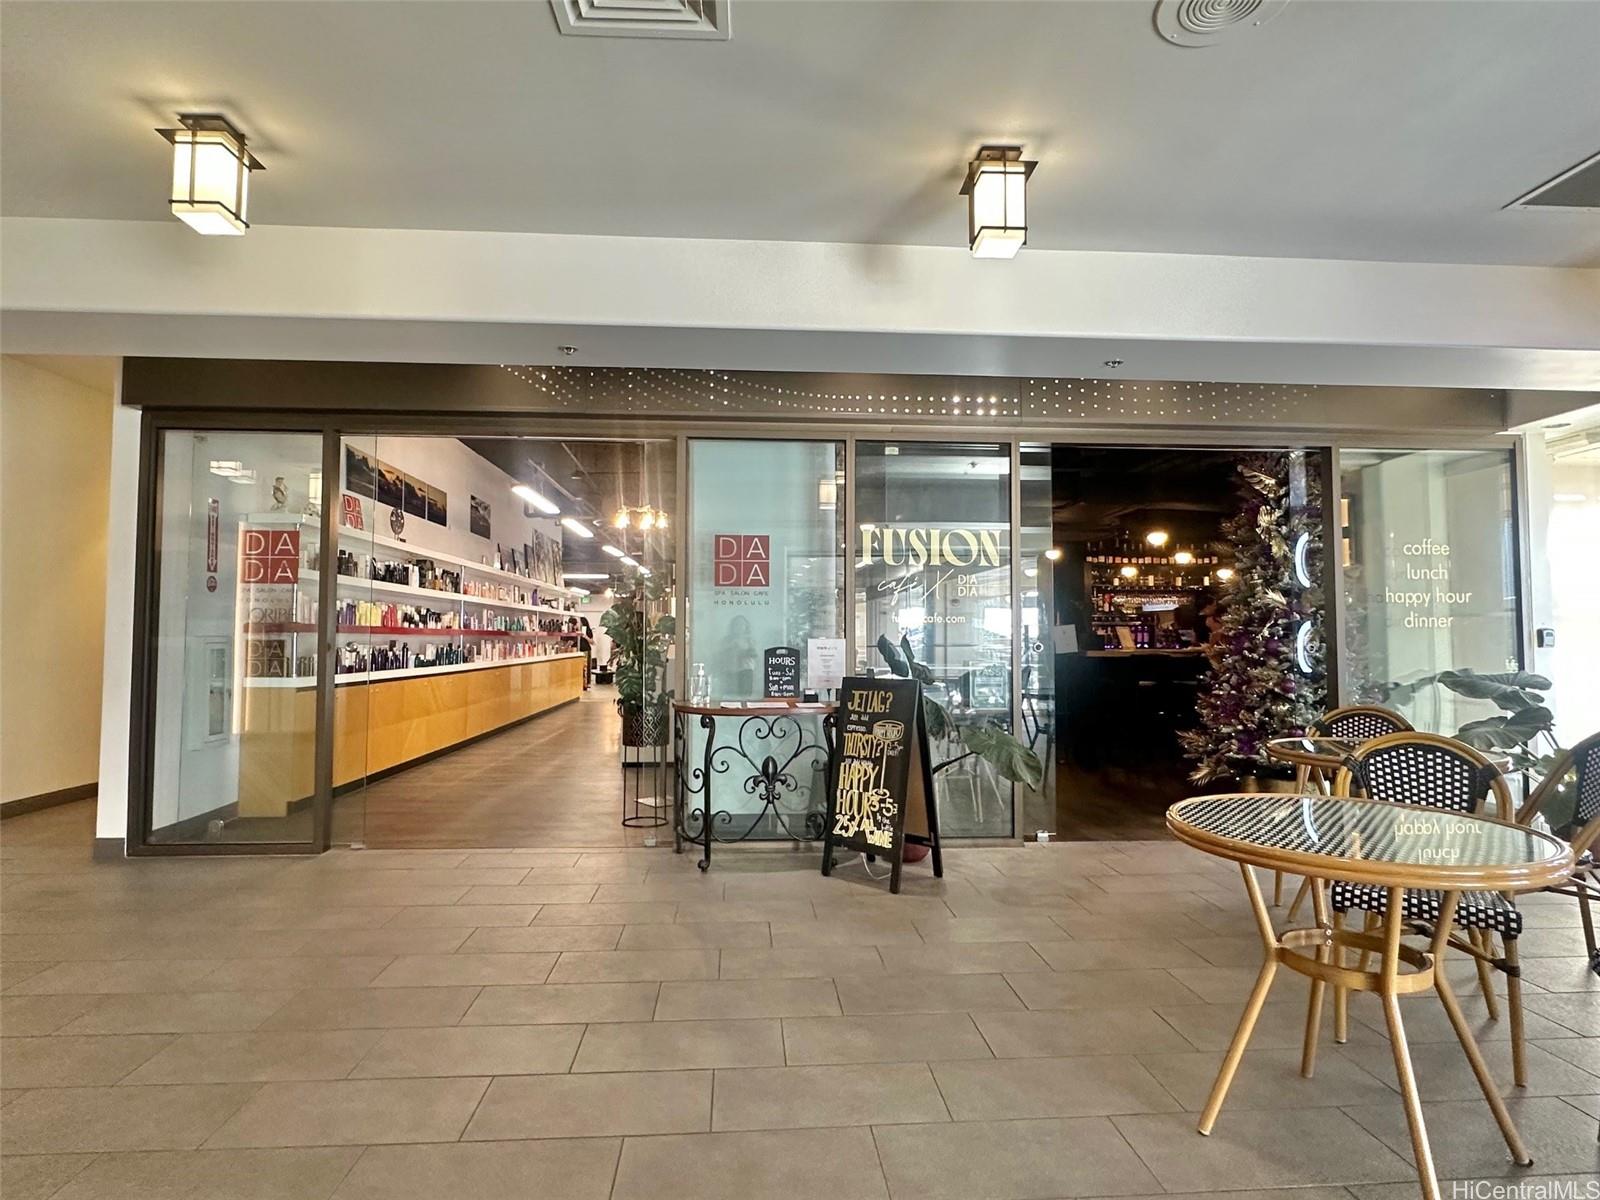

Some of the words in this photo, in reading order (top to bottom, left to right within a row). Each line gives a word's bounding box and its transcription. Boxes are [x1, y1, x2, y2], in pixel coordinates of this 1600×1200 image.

[720, 536, 766, 558] DA
[861, 527, 1001, 567] FUSION
[1403, 538, 1450, 556] coffee
[719, 563, 766, 585] DA
[1406, 563, 1449, 580] lunch
[1385, 587, 1431, 608] happy
[1436, 587, 1473, 604] hour
[1404, 612, 1453, 628] dinner
[768, 657, 796, 666] HOURS
[843, 732, 884, 758] THIRSTY?
[839, 761, 880, 794] HAPPY
[836, 788, 873, 819] HOUR
